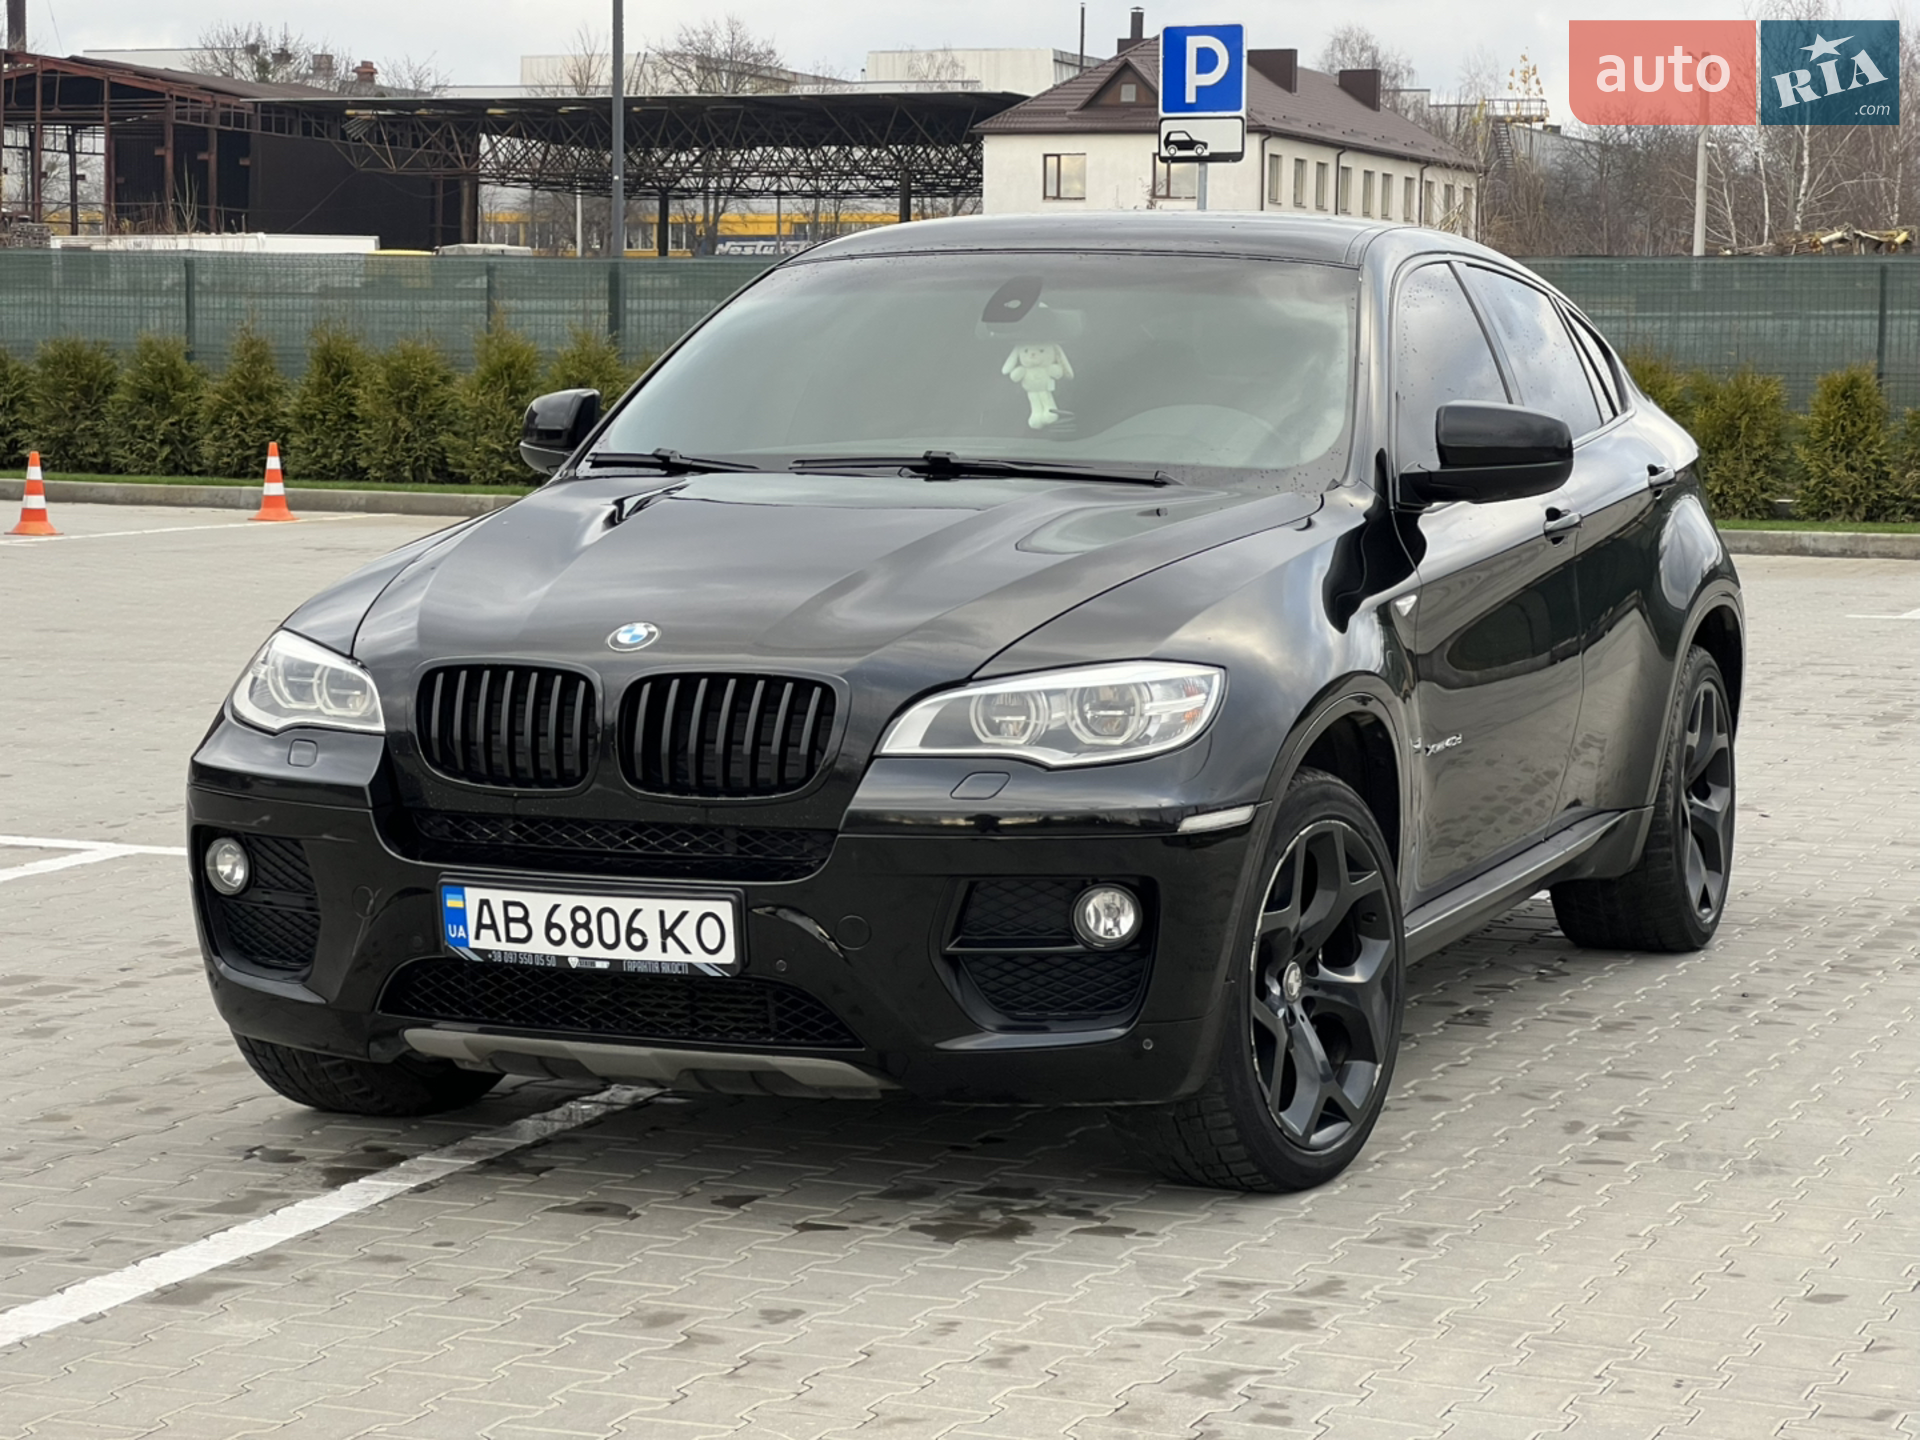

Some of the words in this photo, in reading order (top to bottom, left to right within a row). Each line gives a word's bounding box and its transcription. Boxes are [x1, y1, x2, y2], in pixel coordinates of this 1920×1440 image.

[1185, 35, 1229, 103] P
[448, 924, 467, 939] UA
[474, 898, 533, 944] AB
[545, 904, 649, 952] 6806
[659, 909, 726, 956] KO
